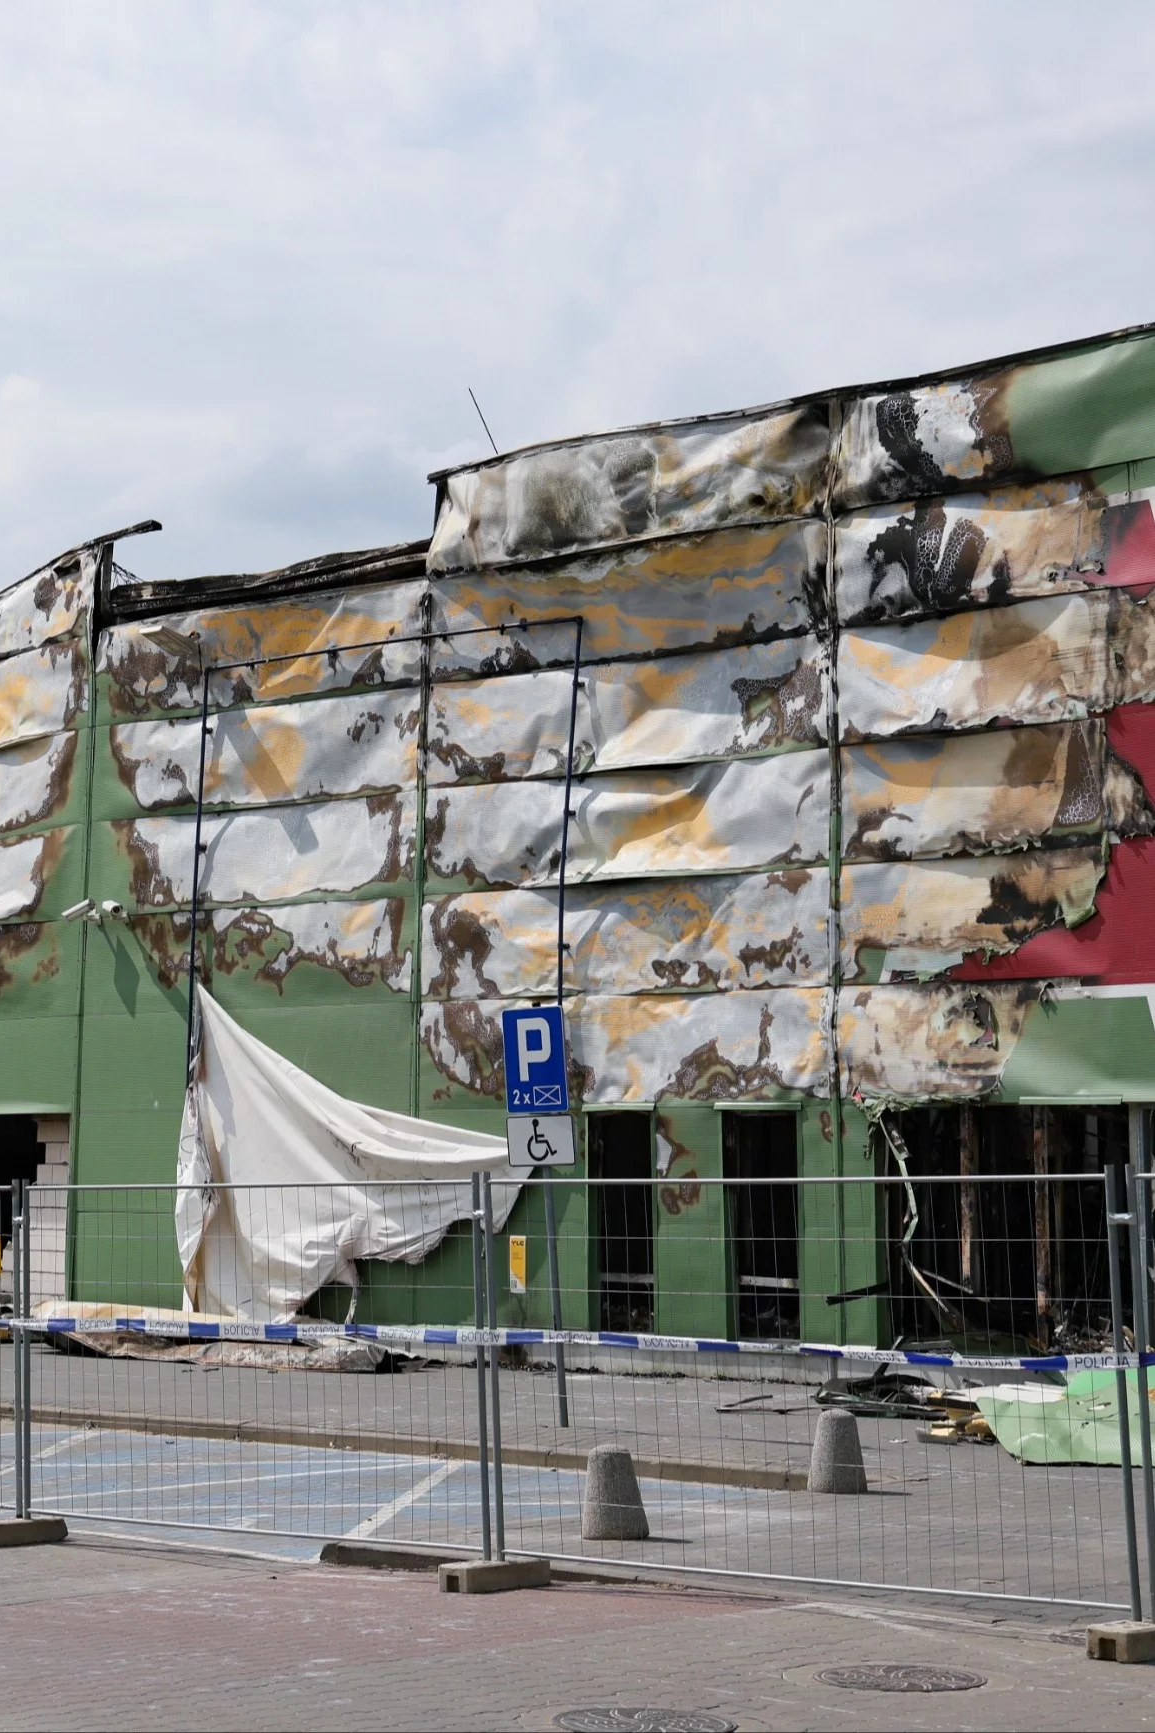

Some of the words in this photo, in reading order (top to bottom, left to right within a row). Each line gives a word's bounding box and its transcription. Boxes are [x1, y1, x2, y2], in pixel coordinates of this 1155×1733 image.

[517, 1017, 551, 1082] P
[513, 1089, 520, 1104] 2
[523, 1093, 531, 1104] x
[1075, 1356, 1130, 1368] POLICJA
